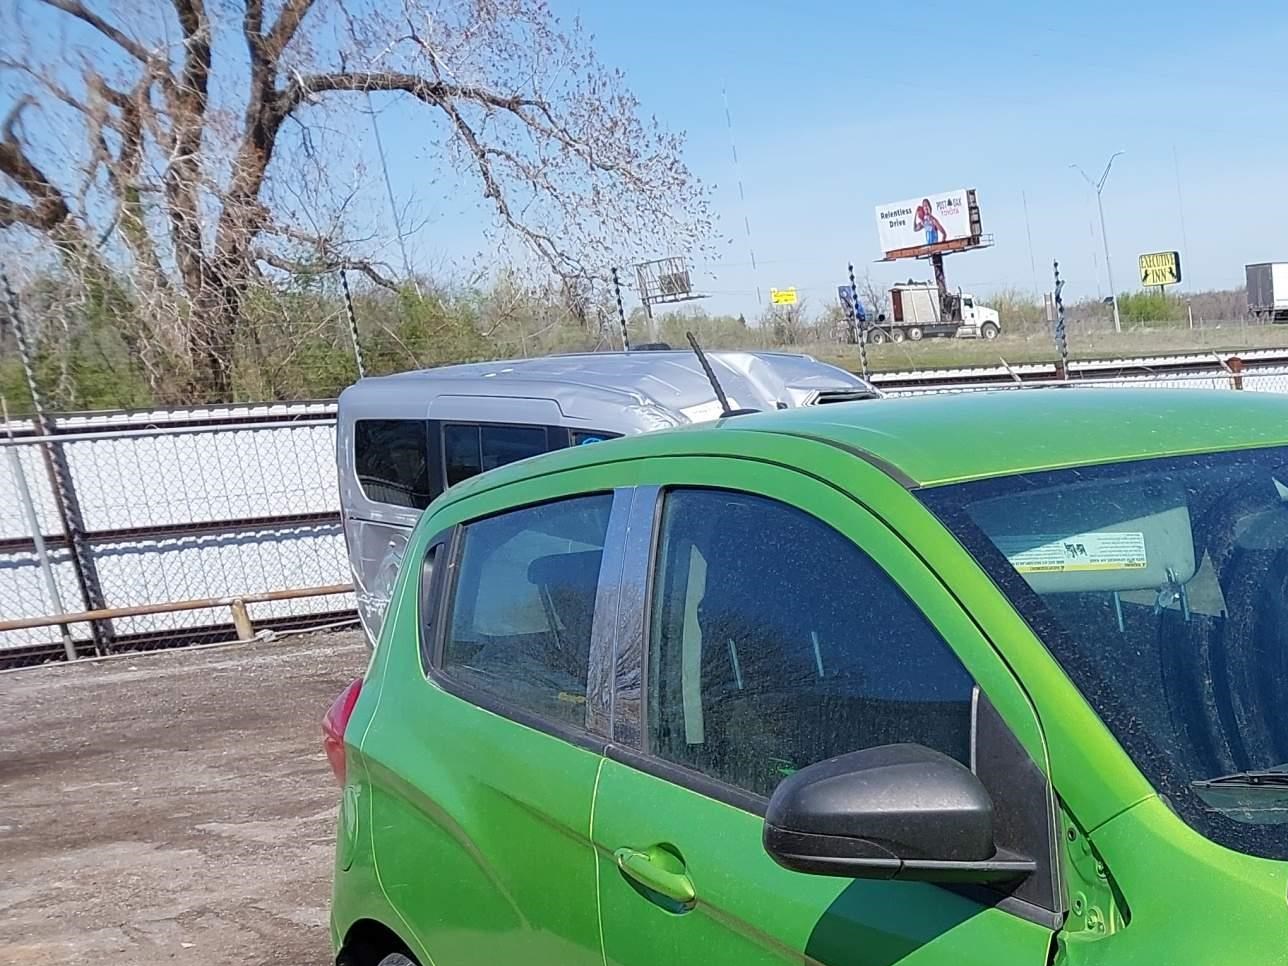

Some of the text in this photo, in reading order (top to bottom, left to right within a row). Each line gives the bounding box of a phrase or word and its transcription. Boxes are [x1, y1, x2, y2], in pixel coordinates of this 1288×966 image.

[880, 208, 912, 219] Relentless
[889, 219, 907, 228] Drive
[1141, 254, 1174, 268] EXECUTIVE
[1152, 268, 1168, 283] INN
